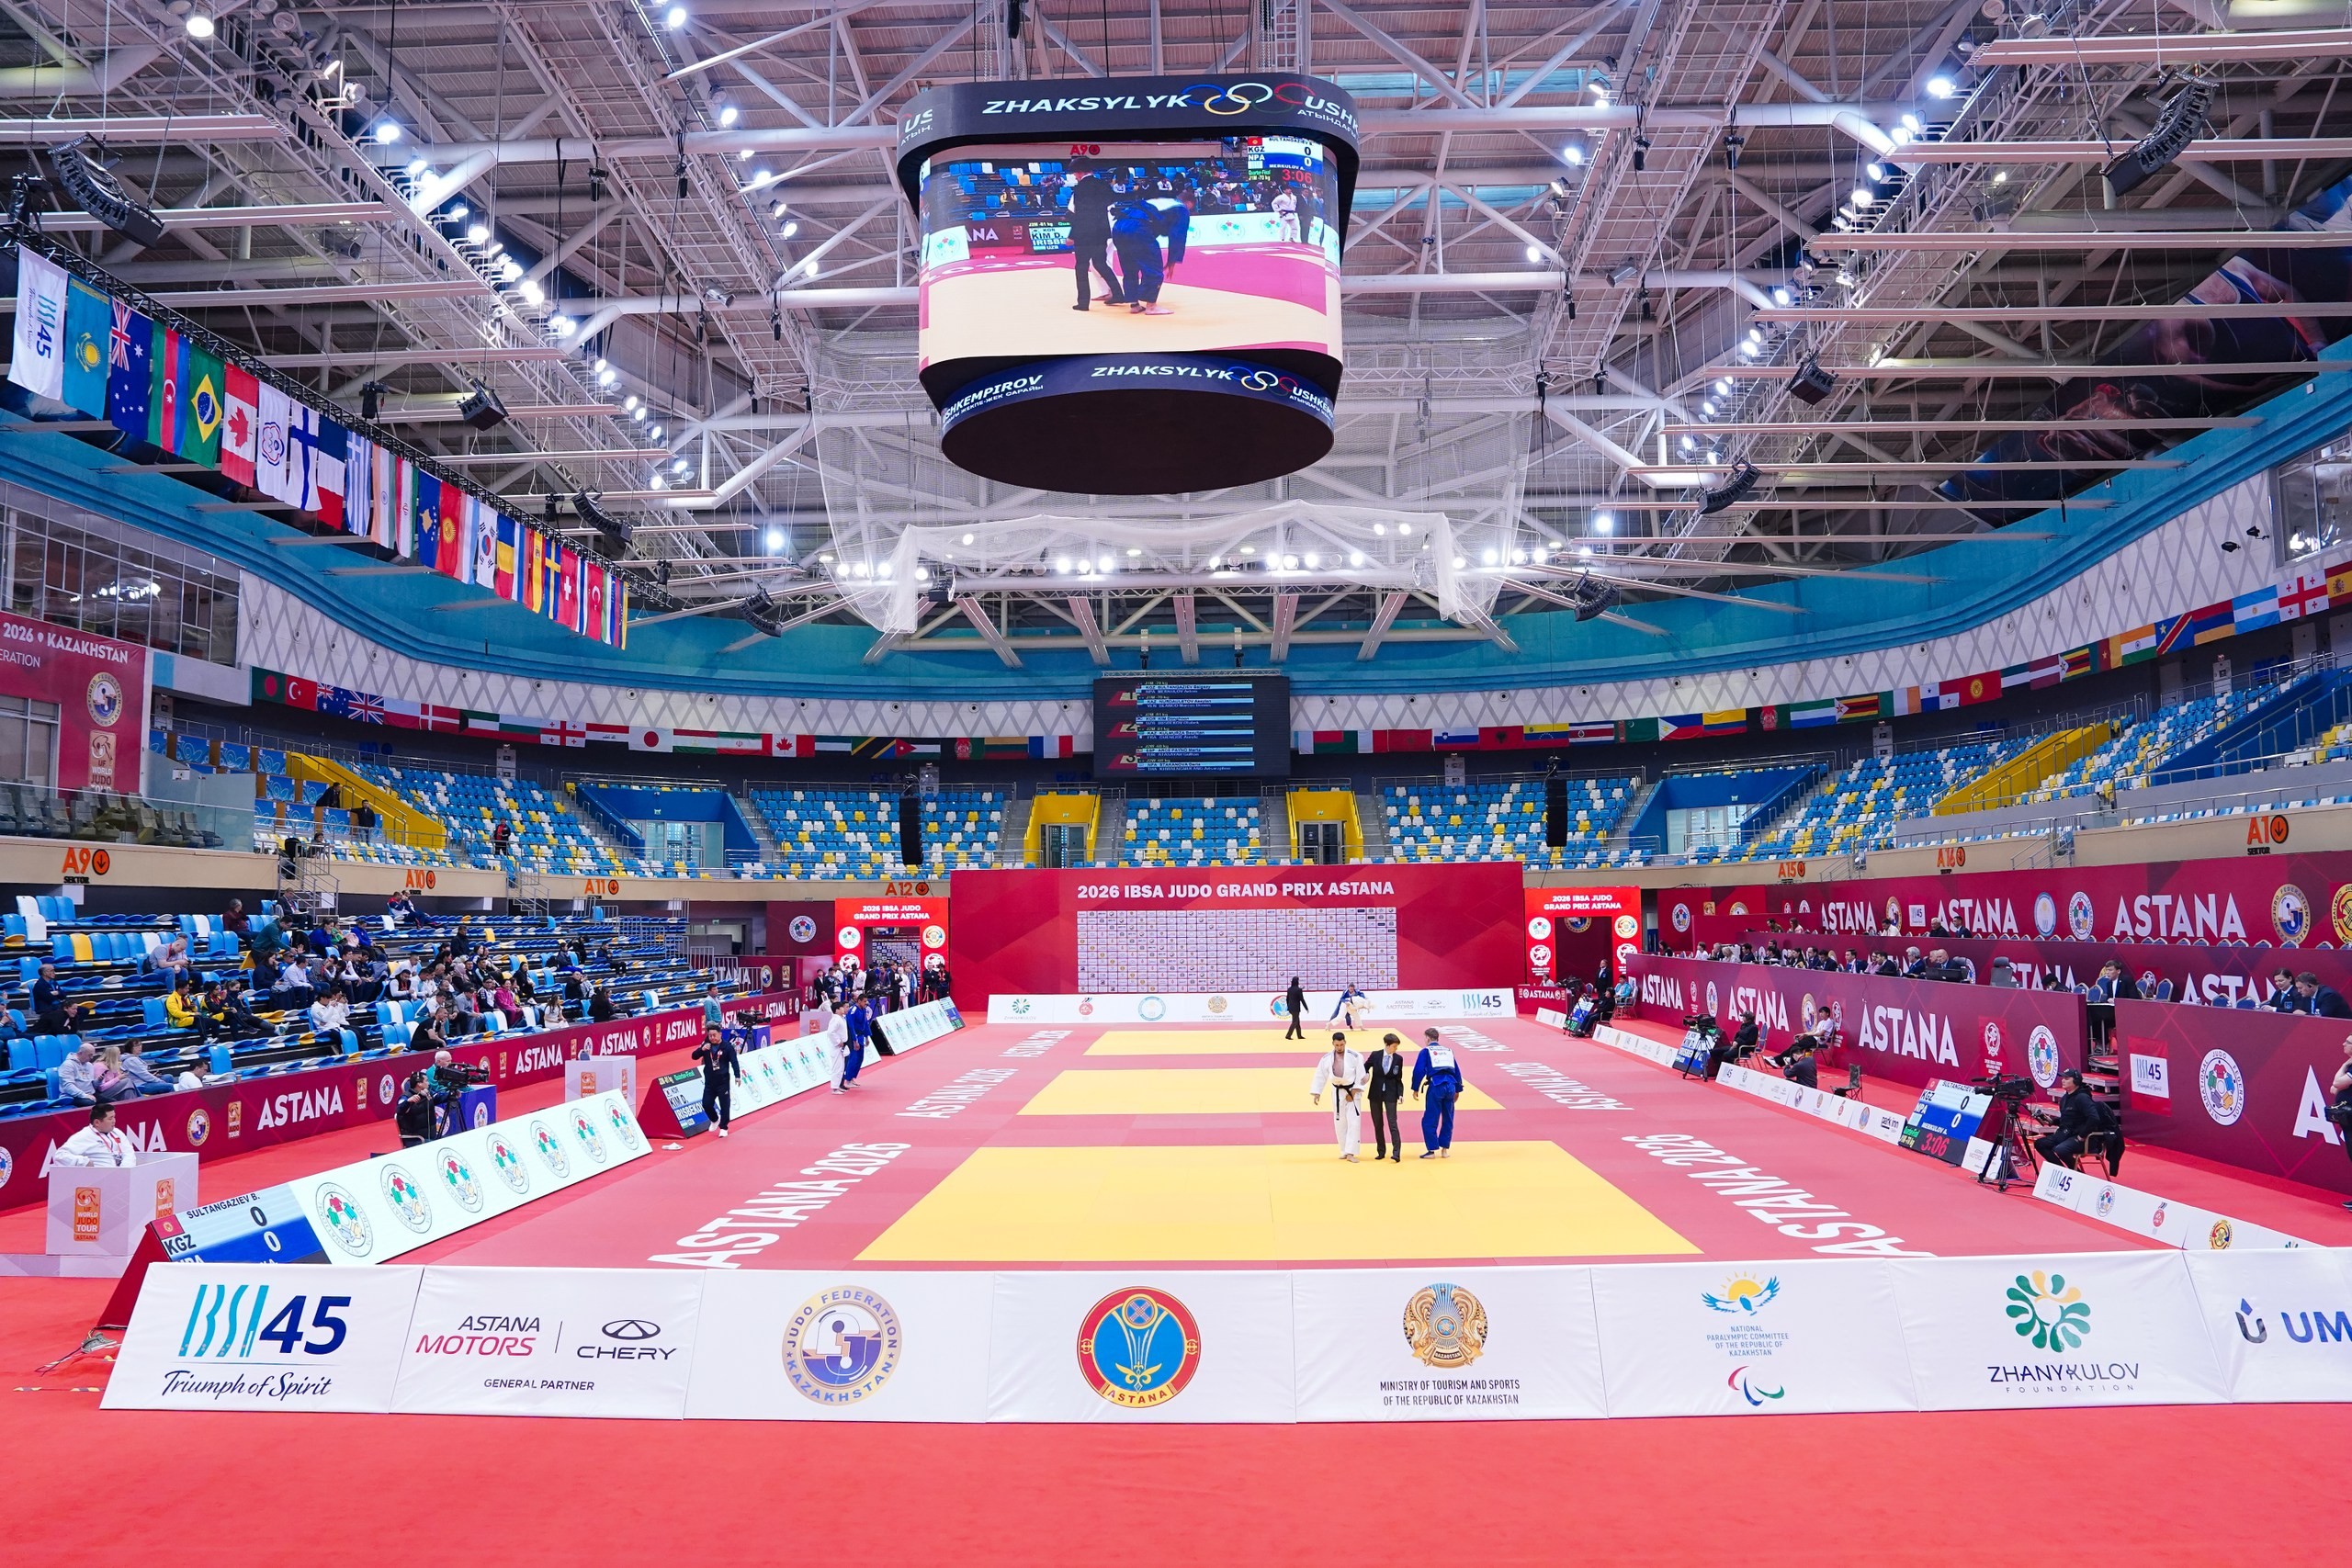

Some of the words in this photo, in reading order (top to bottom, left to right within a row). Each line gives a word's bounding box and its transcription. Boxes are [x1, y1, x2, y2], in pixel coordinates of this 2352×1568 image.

[982, 95, 1192, 114] ZHAKSYLYK
[1305, 147, 1311, 155] 0
[1305, 157, 1312, 166] 0
[1282, 169, 1312, 184] 3:06
[1091, 366, 1234, 380] ZHAKSYLYK
[4, 622, 33, 643] 2026
[47, 632, 128, 664] KAZAKHSTAN
[91, 775, 112, 785] JUDO
[2247, 816, 2269, 845] A1
[62, 847, 90, 874] A9
[1937, 848, 1955, 867] A16
[405, 869, 425, 889] A10
[1778, 862, 1796, 878] A15
[584, 879, 605, 895] A11
[885, 882, 912, 896] A12
[1078, 886, 1119, 898] 2026
[1125, 886, 1163, 897] IBSA
[1168, 885, 1212, 897] JUDO
[1216, 884, 1277, 897] GRAND
[1282, 883, 1323, 896] PRIX
[1328, 882, 1394, 895] ASTANA
[1822, 901, 1877, 932] ASTANA
[2113, 892, 2246, 938] ASTANA
[1482, 995, 1501, 1008] 45
[1529, 990, 1555, 999] ASTANA
[1642, 974, 1683, 1010] ASTANA
[765, 1000, 786, 1019] ASTANA
[665, 1017, 696, 1041] ASTANA
[1859, 1003, 1959, 1067] ASTANA
[600, 1031, 637, 1055] ASTANA
[515, 1043, 563, 1074] ASTANA
[2148, 1064, 2161, 1080] 45
[669, 1096, 680, 1108] KIM
[1921, 1091, 1935, 1101] KGZ
[1961, 1096, 1970, 1110] 0
[257, 1086, 344, 1131] ASTANA
[1915, 1103, 1928, 1114] NPA
[1951, 1113, 1962, 1128] 0
[1622, 1134, 1747, 1167] 2026
[1921, 1133, 1950, 1156] 3:06
[2059, 1176, 2073, 1191] 45
[187, 1195, 251, 1219] SULTANGAZIEV
[251, 1192, 260, 1201] B.
[647, 1179, 862, 1269] ASTANA
[800, 1142, 911, 1176] 2026
[1686, 1167, 1938, 1258] ASTANA
[249, 1206, 267, 1226] 0
[164, 1235, 197, 1255] KGZ
[263, 1231, 281, 1252] 0
[259, 1295, 352, 1355] 45
[458, 1315, 540, 1332] ASTANA
[787, 1306, 812, 1348] JUDO
[821, 1290, 898, 1348] FEDERATION
[415, 1335, 537, 1356] MOTORS
[576, 1346, 677, 1360] CHERY
[787, 1359, 892, 1402] KAZAKHSTAN
[1987, 1363, 2139, 1382] ZHANYKULOV
[162, 1370, 245, 1401] Triumph
[248, 1375, 275, 1397] of
[268, 1371, 332, 1401] Spirit
[484, 1379, 537, 1389] GENERAL
[540, 1380, 594, 1391] PARTNER
[1380, 1381, 1418, 1391] MINISTRY
[1420, 1380, 1430, 1390] OF
[1433, 1380, 1468, 1390] TOURISM
[1470, 1380, 1487, 1390] AND
[1489, 1379, 1520, 1390] SPORTS
[2006, 1384, 2134, 1393] FOUNDATION
[1107, 1390, 1168, 1404] ASTANA
[1384, 1395, 1393, 1405] OF
[1395, 1395, 1410, 1405] THE
[1413, 1395, 1452, 1405] REPUBLIC
[1454, 1395, 1464, 1404] OF
[1465, 1394, 1519, 1404] KAZAKHSTAN
